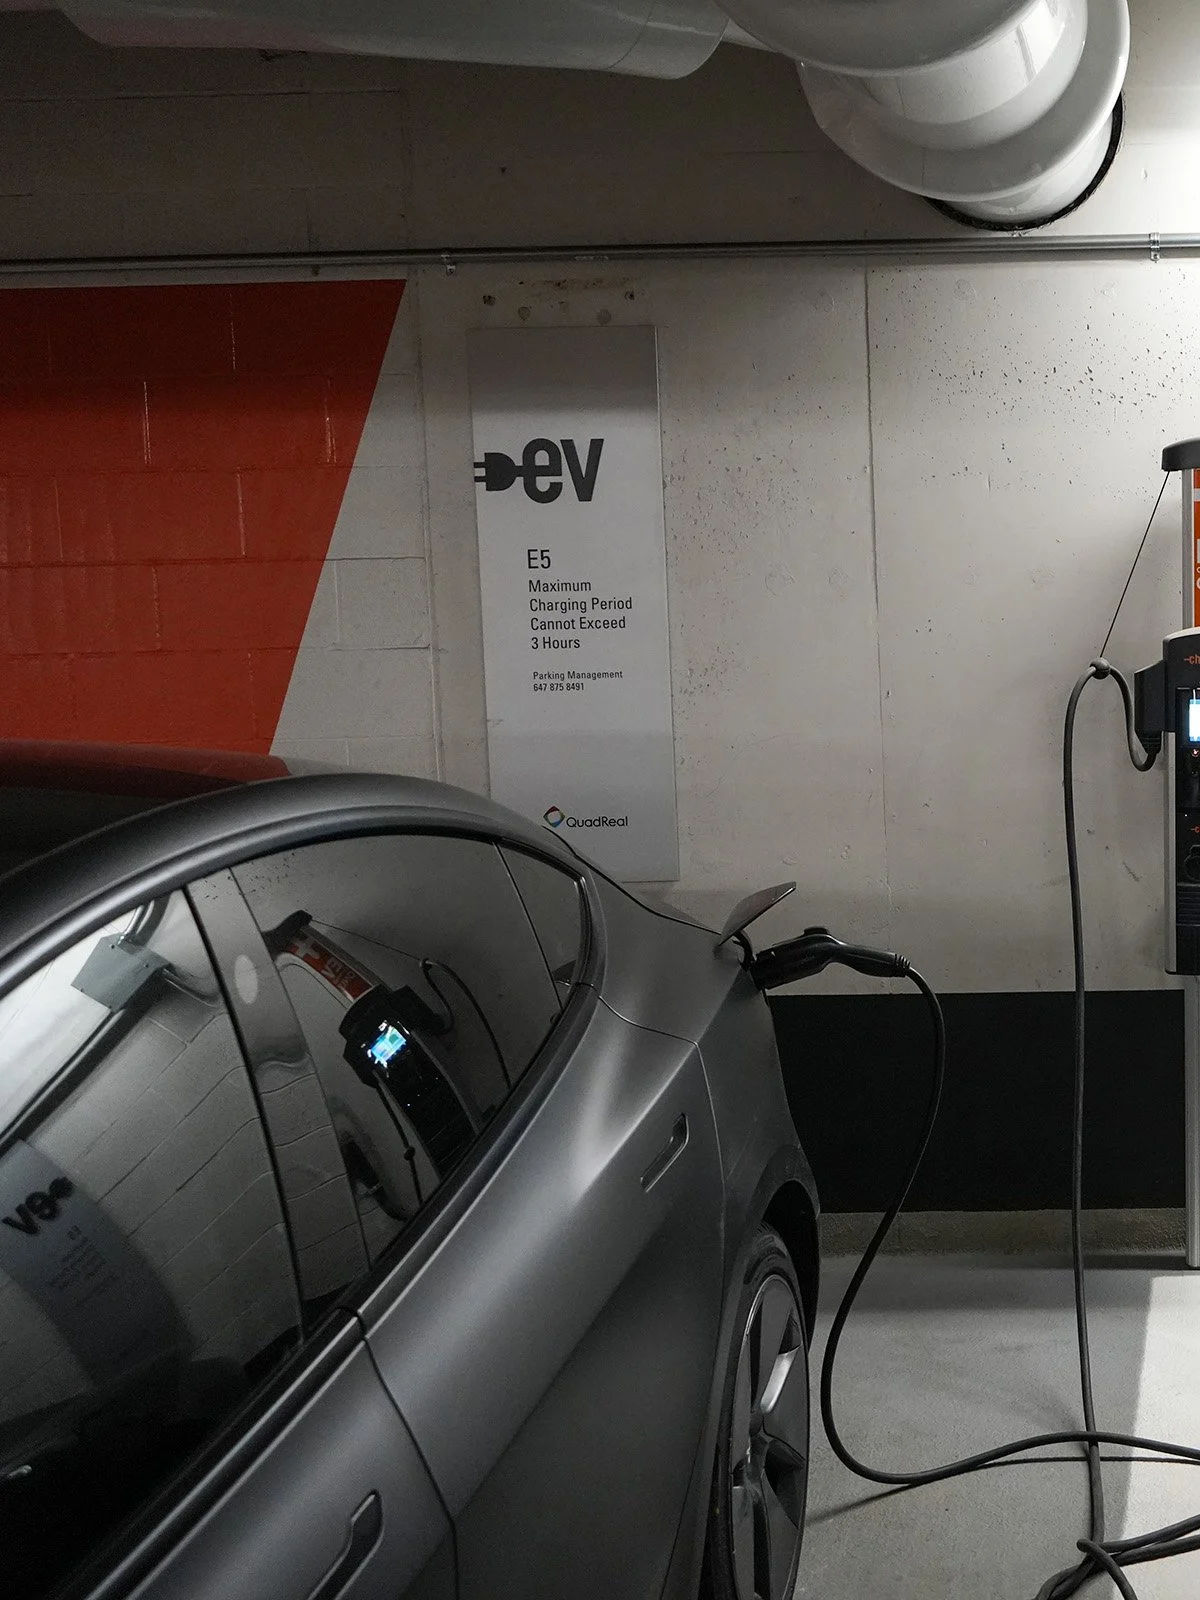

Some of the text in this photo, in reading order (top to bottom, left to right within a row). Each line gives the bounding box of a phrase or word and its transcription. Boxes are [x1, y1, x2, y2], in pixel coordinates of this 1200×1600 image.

[521, 437, 605, 504] ev
[527, 548, 551, 570] E5
[528, 578, 592, 593] Maximum
[529, 596, 633, 614] Charging Period
[530, 615, 626, 631] Cannot Exceed
[531, 636, 581, 650] 3 Hours
[532, 670, 624, 682] Parking Management
[533, 682, 584, 692] 647 875 8491
[565, 815, 629, 828] QuadReal
